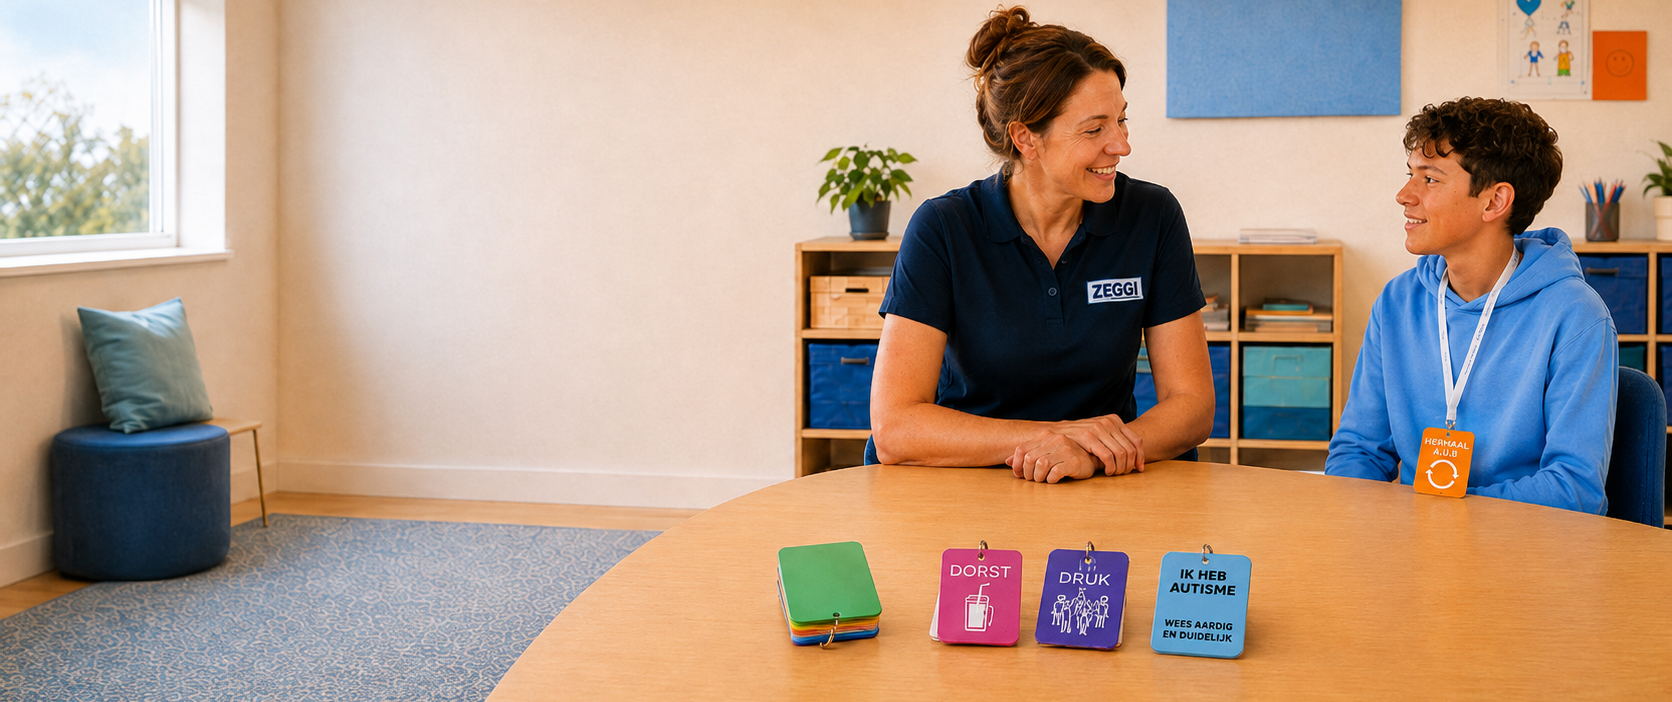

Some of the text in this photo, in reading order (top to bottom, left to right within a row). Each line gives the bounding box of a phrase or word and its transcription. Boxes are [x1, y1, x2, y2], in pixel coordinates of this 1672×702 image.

[1091, 281, 1138, 299] ZEGGI
[950, 564, 1012, 578] DORST
[1180, 569, 1227, 581] IK HEB
[1059, 571, 1111, 586] DRUK
[1169, 582, 1236, 596] AUTISME
[1164, 619, 1233, 631] WEES AARDIG
[1162, 630, 1232, 643] EN DUIDELIJK
